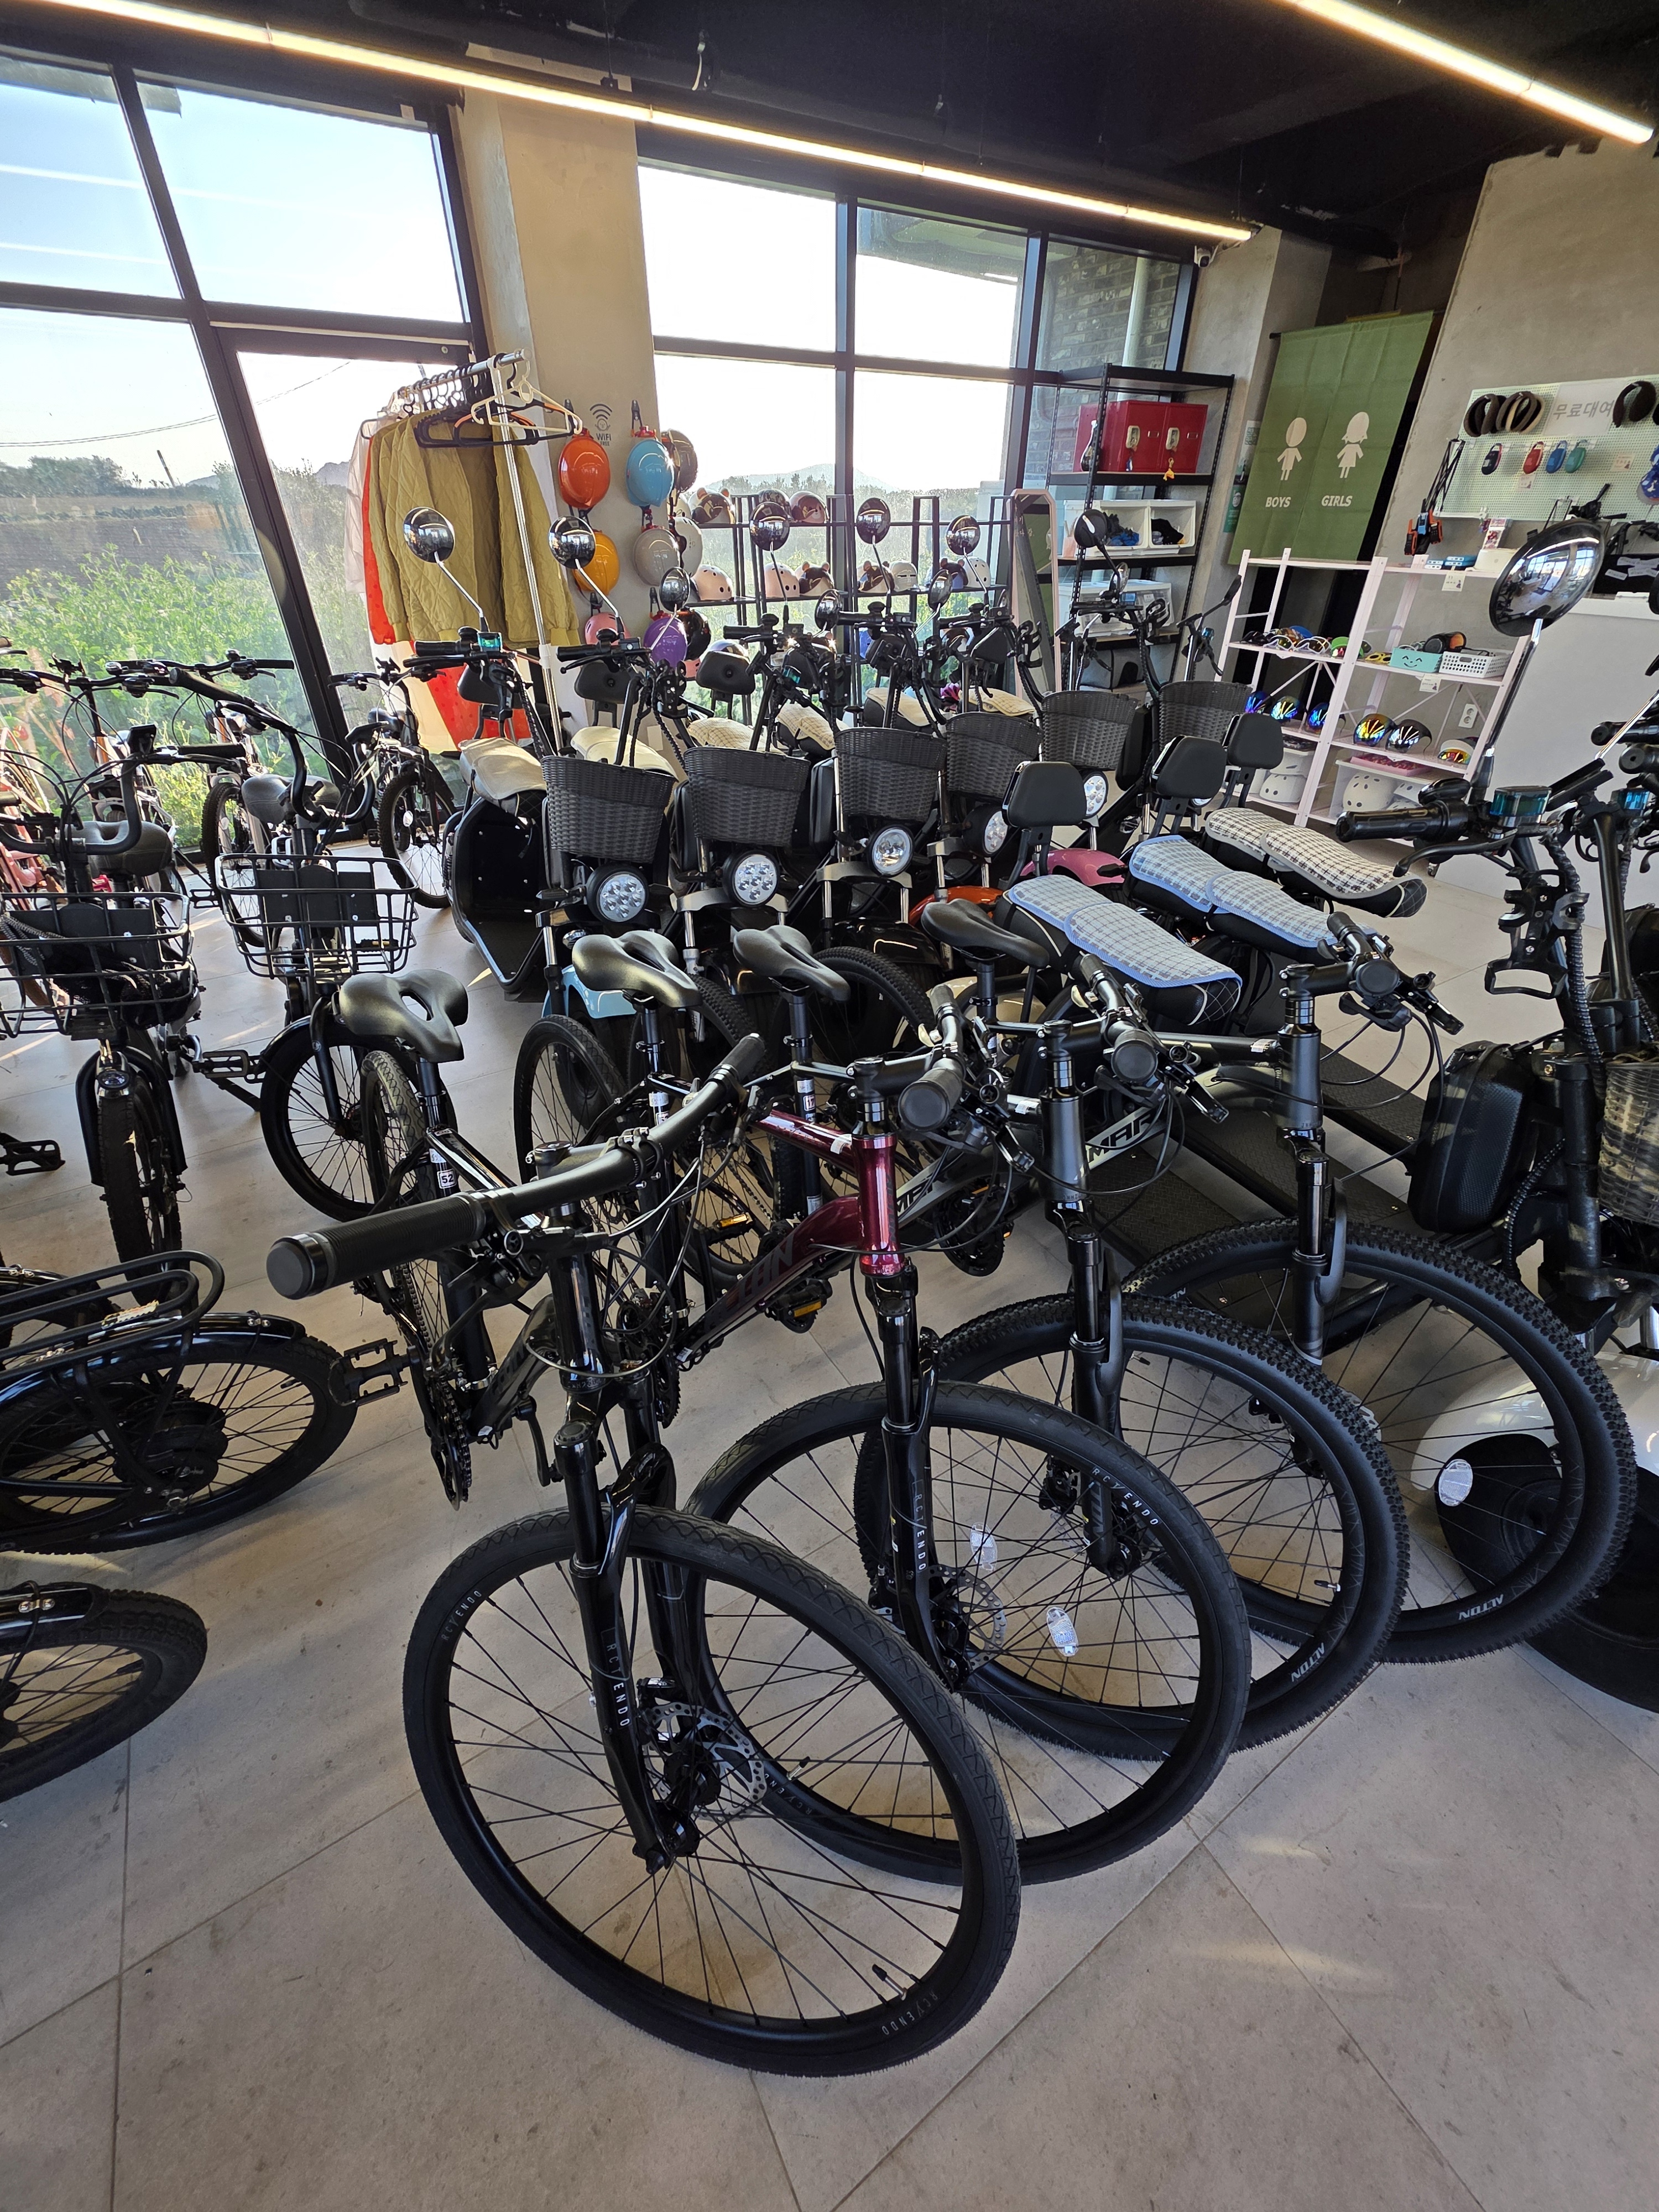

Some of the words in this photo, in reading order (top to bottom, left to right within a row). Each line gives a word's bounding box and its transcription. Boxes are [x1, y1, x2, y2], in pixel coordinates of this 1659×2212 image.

[1553, 400, 1615, 420] 무료대여
[1265, 497, 1291, 507] BOYS
[1321, 495, 1353, 507] GIRLS
[442, 1174, 454, 1184] 52
[1459, 1594, 1504, 1620] ALTON
[1291, 1642, 1325, 1682] ALTON
